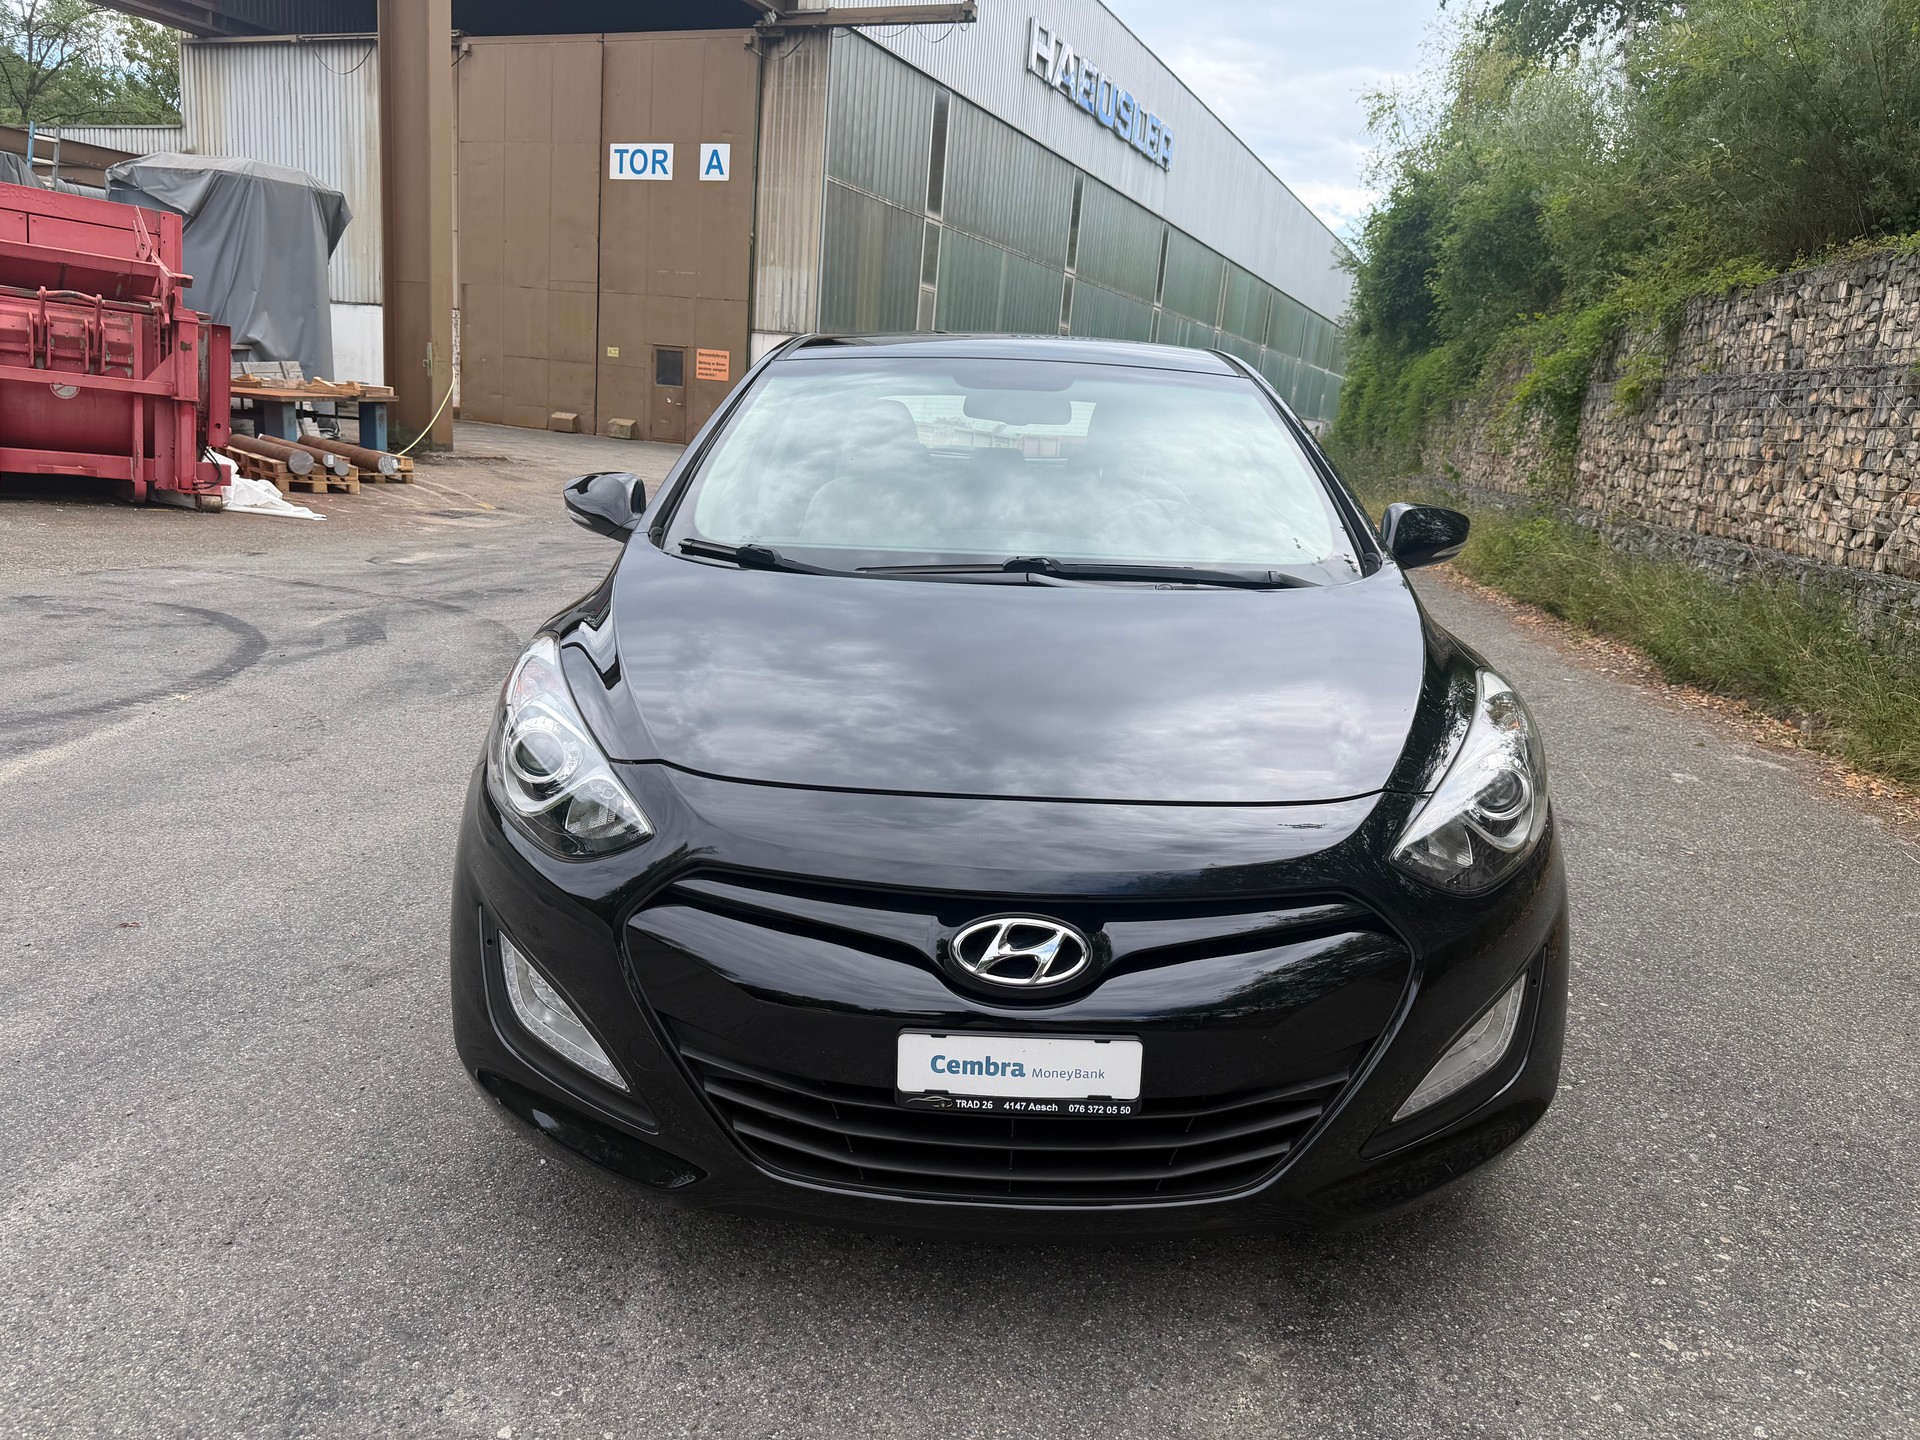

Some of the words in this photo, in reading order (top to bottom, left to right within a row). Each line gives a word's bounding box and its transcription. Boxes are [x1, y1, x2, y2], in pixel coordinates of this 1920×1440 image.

[1028, 16, 1174, 171] HAEUSLER
[614, 149, 669, 175] TOR
[705, 149, 725, 175] A
[930, 1054, 1027, 1078] Cembra
[1031, 1067, 1105, 1081] MoneyBank
[955, 1099, 980, 1109] TRAD
[982, 1100, 993, 1109] 26
[1003, 1101, 1027, 1110] 4147
[1028, 1102, 1058, 1111] Aesch
[1068, 1104, 1085, 1113] 076
[1087, 1105, 1104, 1114] 372
[1106, 1105, 1118, 1114] 05
[1120, 1106, 1131, 1114] 50
